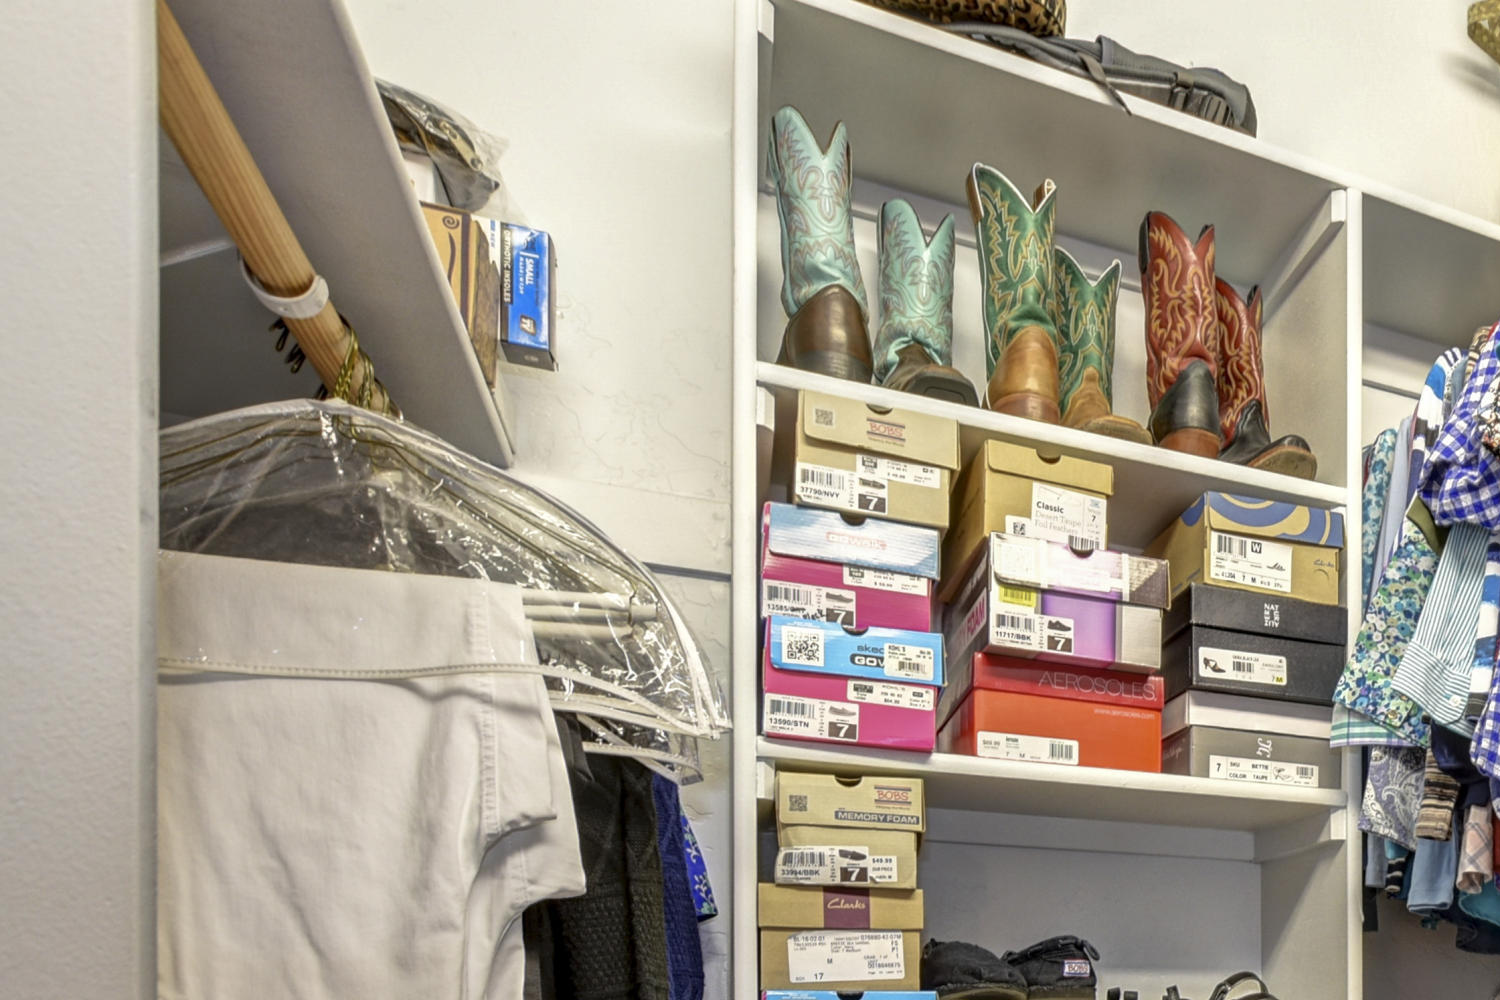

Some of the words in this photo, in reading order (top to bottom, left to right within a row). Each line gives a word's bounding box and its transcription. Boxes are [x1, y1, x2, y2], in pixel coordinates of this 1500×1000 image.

[503, 229, 511, 269] ORTHOTIC
[525, 257, 534, 285] SMALL
[503, 270, 511, 303] INSOLES
[869, 422, 904, 438] BOBS
[865, 496, 878, 511] 7
[1036, 501, 1064, 513] Classic
[1251, 543, 1262, 553] W
[834, 610, 847, 625] 7
[995, 631, 1032, 641] 11717/BBK
[1054, 637, 1066, 651] 7
[769, 717, 809, 728] 13590/STN
[837, 723, 850, 738] 7
[1216, 763, 1221, 772] 7
[877, 790, 909, 801] BOBS
[837, 812, 885, 823] MEMORY
[886, 815, 917, 825] FOAM
[847, 867, 860, 881] 7
[827, 898, 866, 909] Clarks
[814, 973, 824, 981] 17
